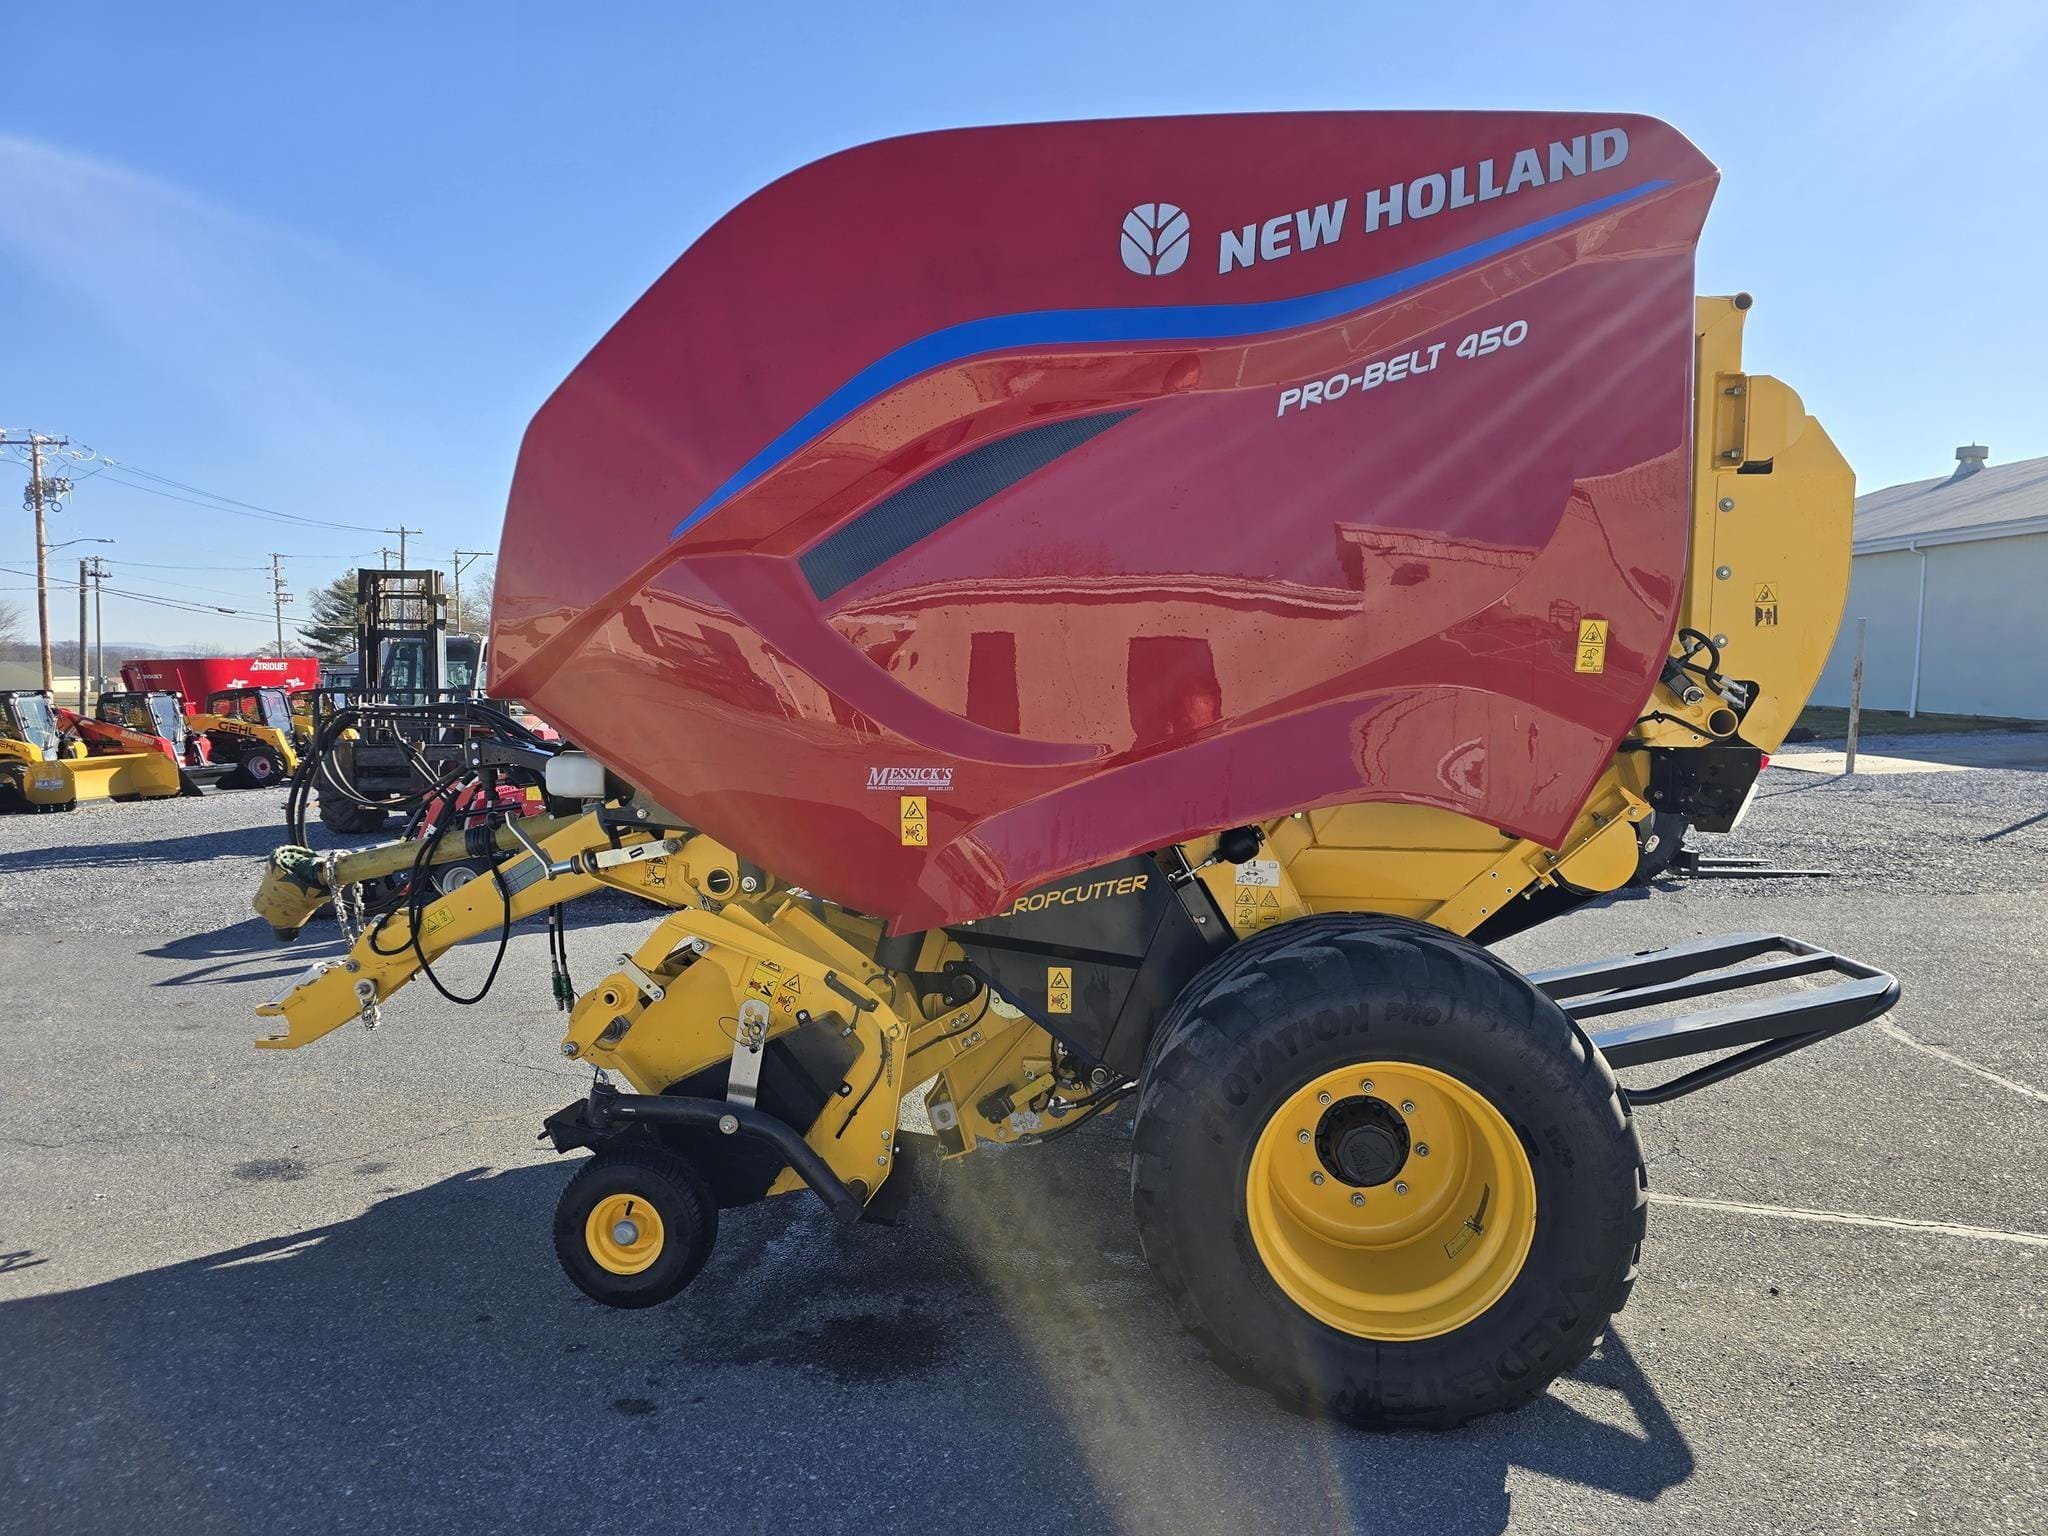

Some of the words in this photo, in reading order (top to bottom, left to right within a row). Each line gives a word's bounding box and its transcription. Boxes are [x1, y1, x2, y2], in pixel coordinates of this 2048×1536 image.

[1218, 198, 1349, 275] NEW
[1364, 127, 1630, 233] HOLLAND
[1276, 341, 1446, 418] PRO-BELT
[1456, 319, 1528, 361] 450
[121, 729, 155, 746] MANITOU
[218, 721, 257, 737] GEHL
[0, 740, 20, 752] EHL
[867, 767, 953, 786] MESSICK'S
[1383, 1001, 1442, 1027] PRO
